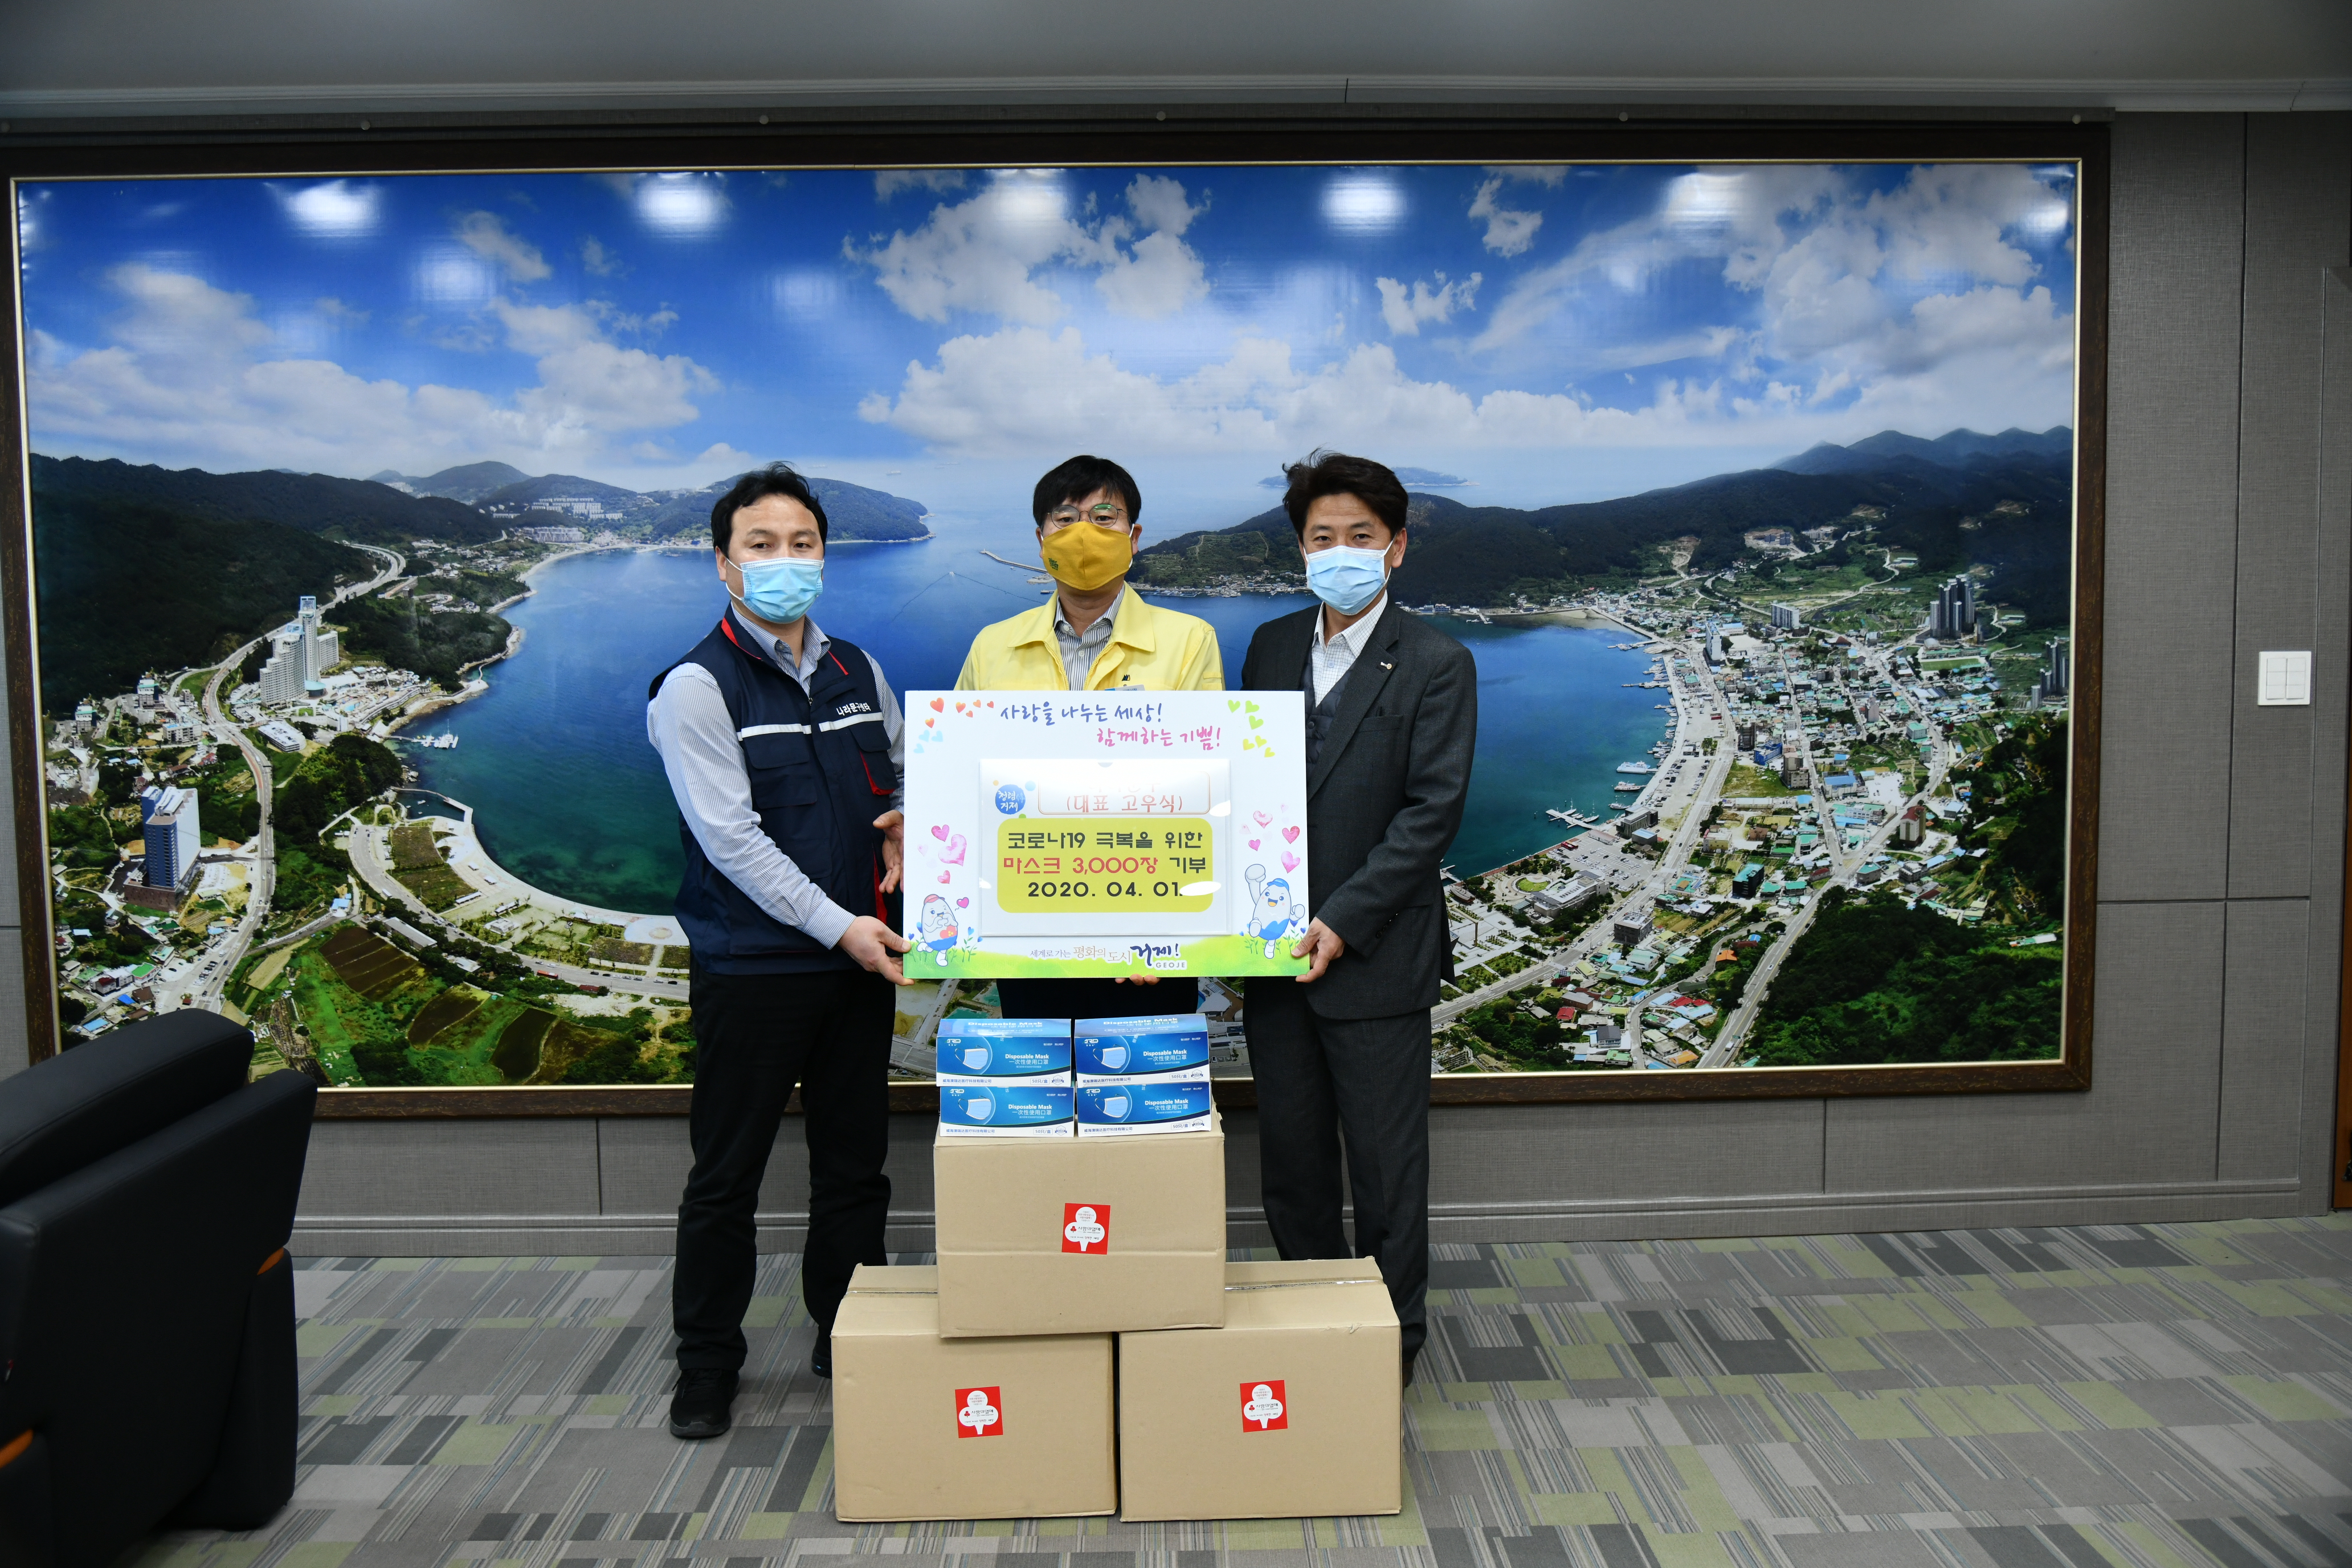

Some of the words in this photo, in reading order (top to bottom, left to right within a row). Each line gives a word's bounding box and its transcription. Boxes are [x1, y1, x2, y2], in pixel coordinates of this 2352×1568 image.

[1001, 701, 1055, 726] 사랑을
[1061, 704, 1108, 722] 나누는
[1114, 703, 1162, 722] 세상!
[1097, 726, 1173, 746] 함께하는
[1179, 725, 1220, 750] 기쁨!
[1000, 802, 1018, 812] 거제
[1067, 795, 1109, 812] (대표
[1008, 832, 1085, 849] 코로나19
[1096, 831, 1153, 849] 극복을
[1165, 832, 1203, 849] 위한
[1003, 857, 1060, 874] 마스크
[1072, 857, 1158, 875] 3,000장
[1169, 857, 1206, 874] 기부
[1028, 881, 1096, 897] 2020.
[1106, 881, 1142, 897] 04.
[1030, 949, 1054, 958] 세계로
[1055, 949, 1071, 958] 가는
[1073, 945, 1106, 958] 평화의
[1108, 950, 1131, 963] 도시
[1130, 943, 1179, 966] 거제!
